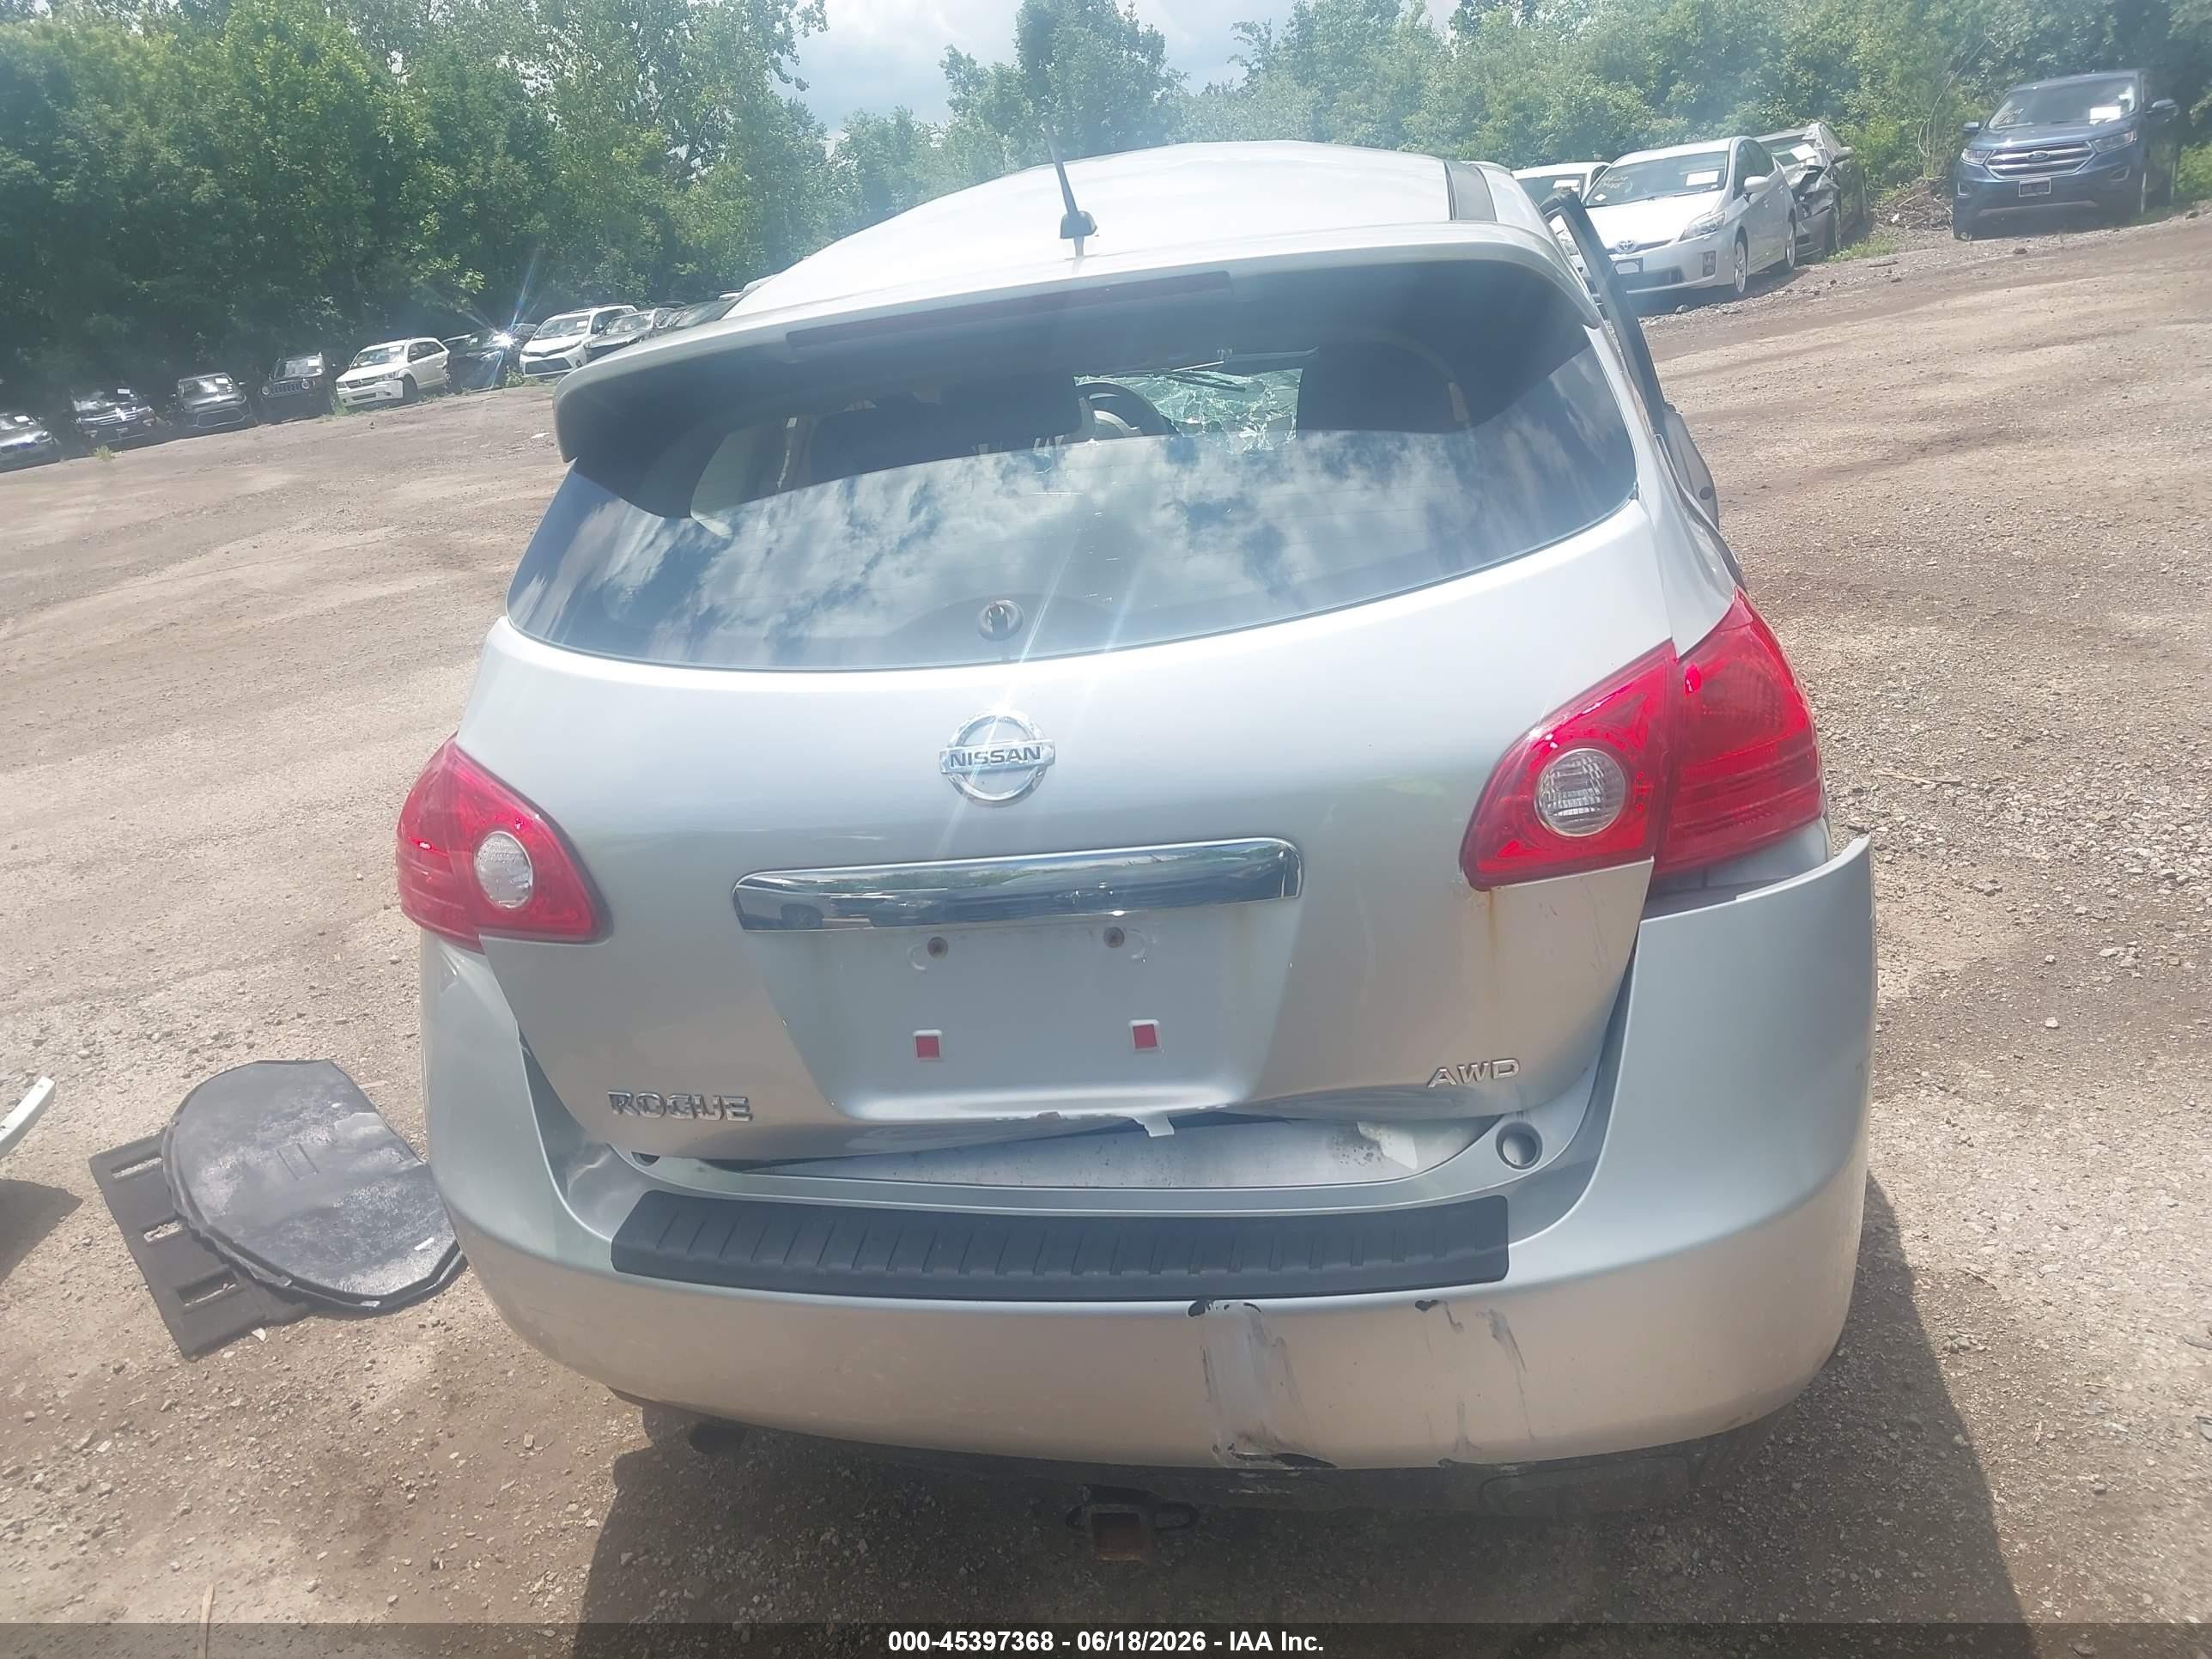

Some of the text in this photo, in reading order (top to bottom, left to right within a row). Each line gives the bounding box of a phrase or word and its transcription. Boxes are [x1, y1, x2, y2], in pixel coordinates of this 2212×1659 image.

[950, 745, 1042, 768] NISSAN
[1427, 1058, 1520, 1088] AWD
[607, 1090, 753, 1121] ROGUE
